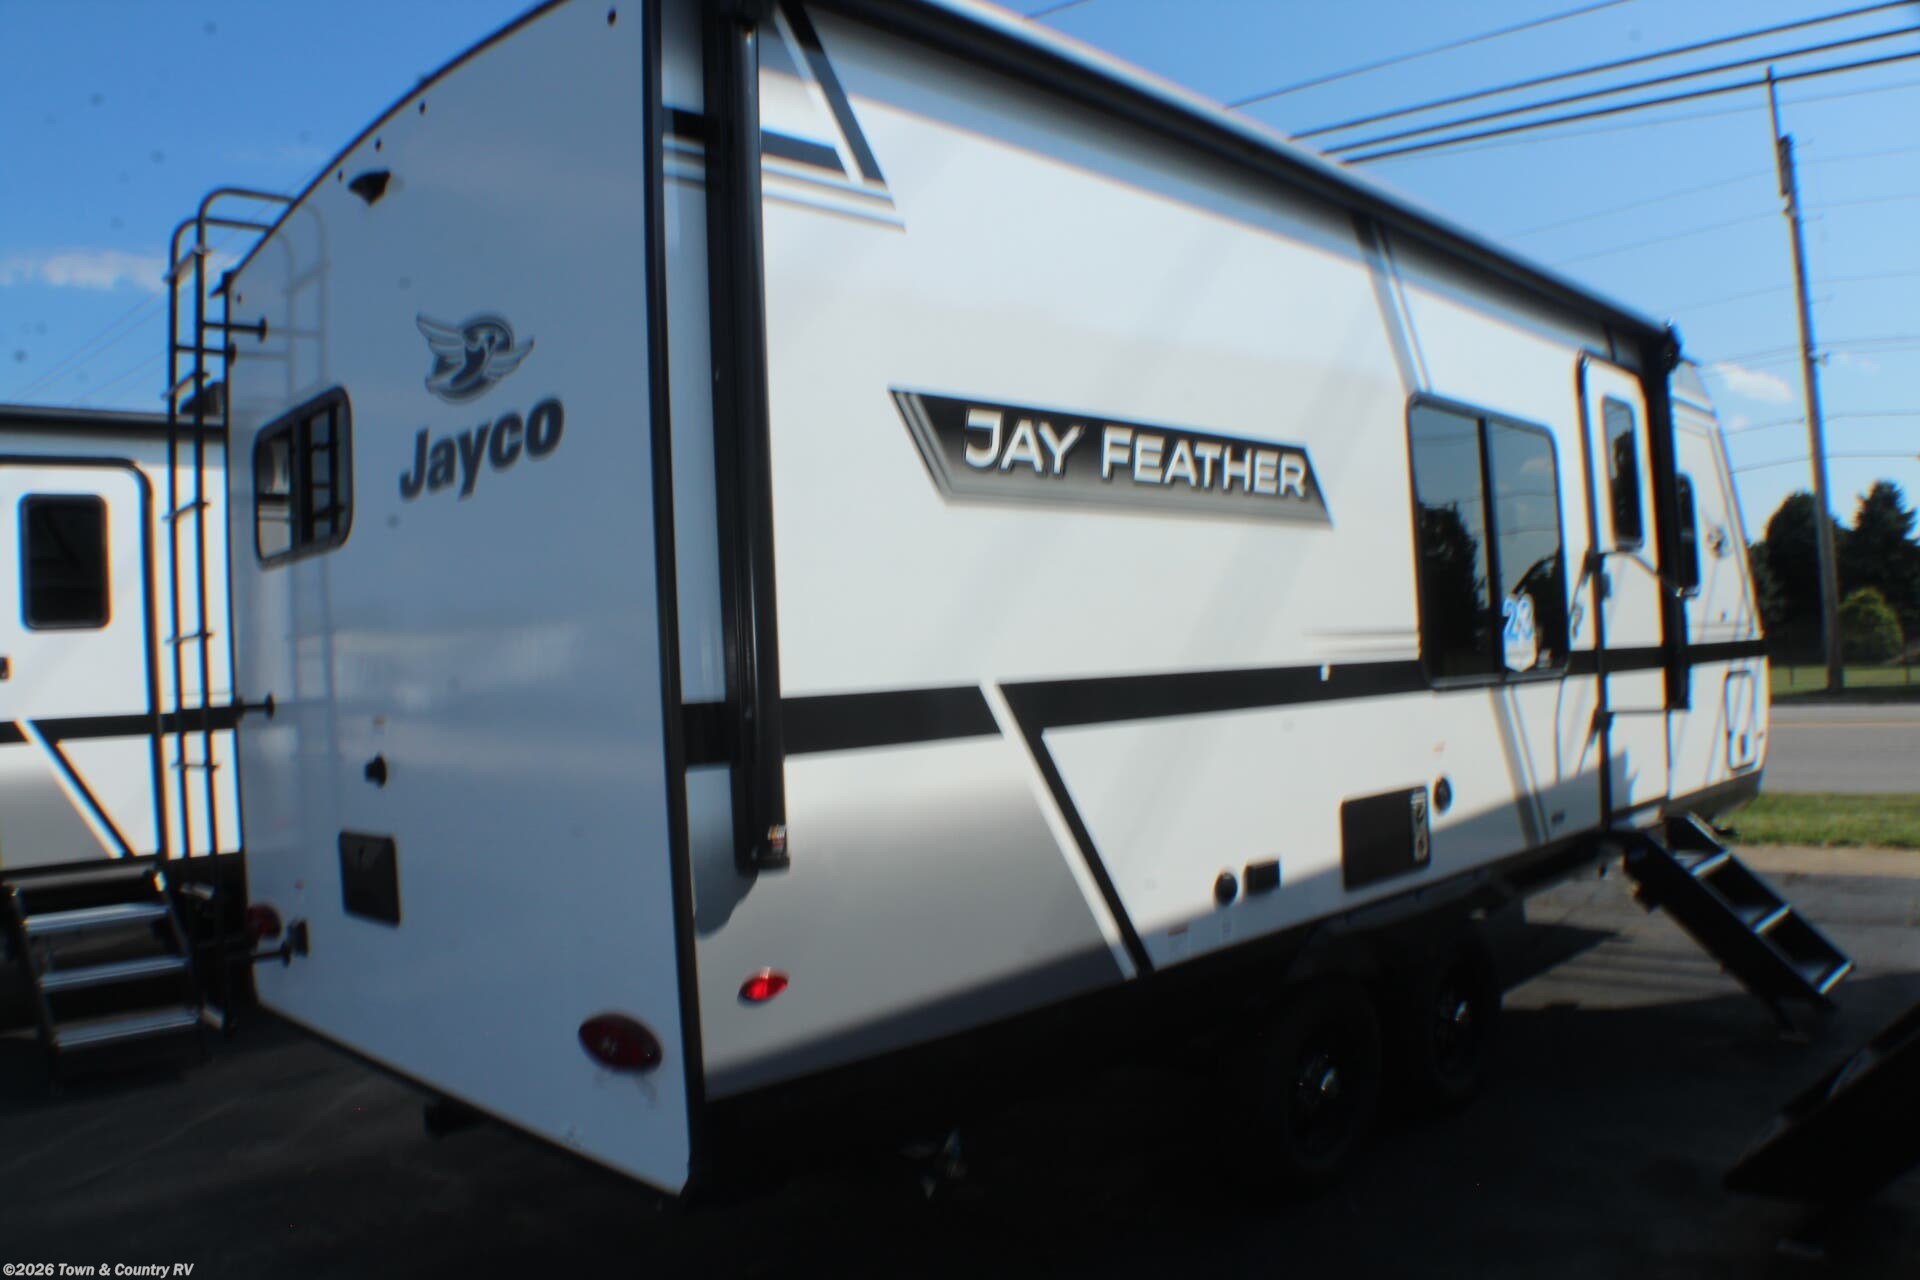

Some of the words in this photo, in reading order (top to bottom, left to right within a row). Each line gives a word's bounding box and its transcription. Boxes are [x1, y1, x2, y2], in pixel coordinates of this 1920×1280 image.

[399, 397, 565, 501] Jayco
[965, 408, 1085, 475] JAY
[1102, 424, 1307, 498] FEATHER
